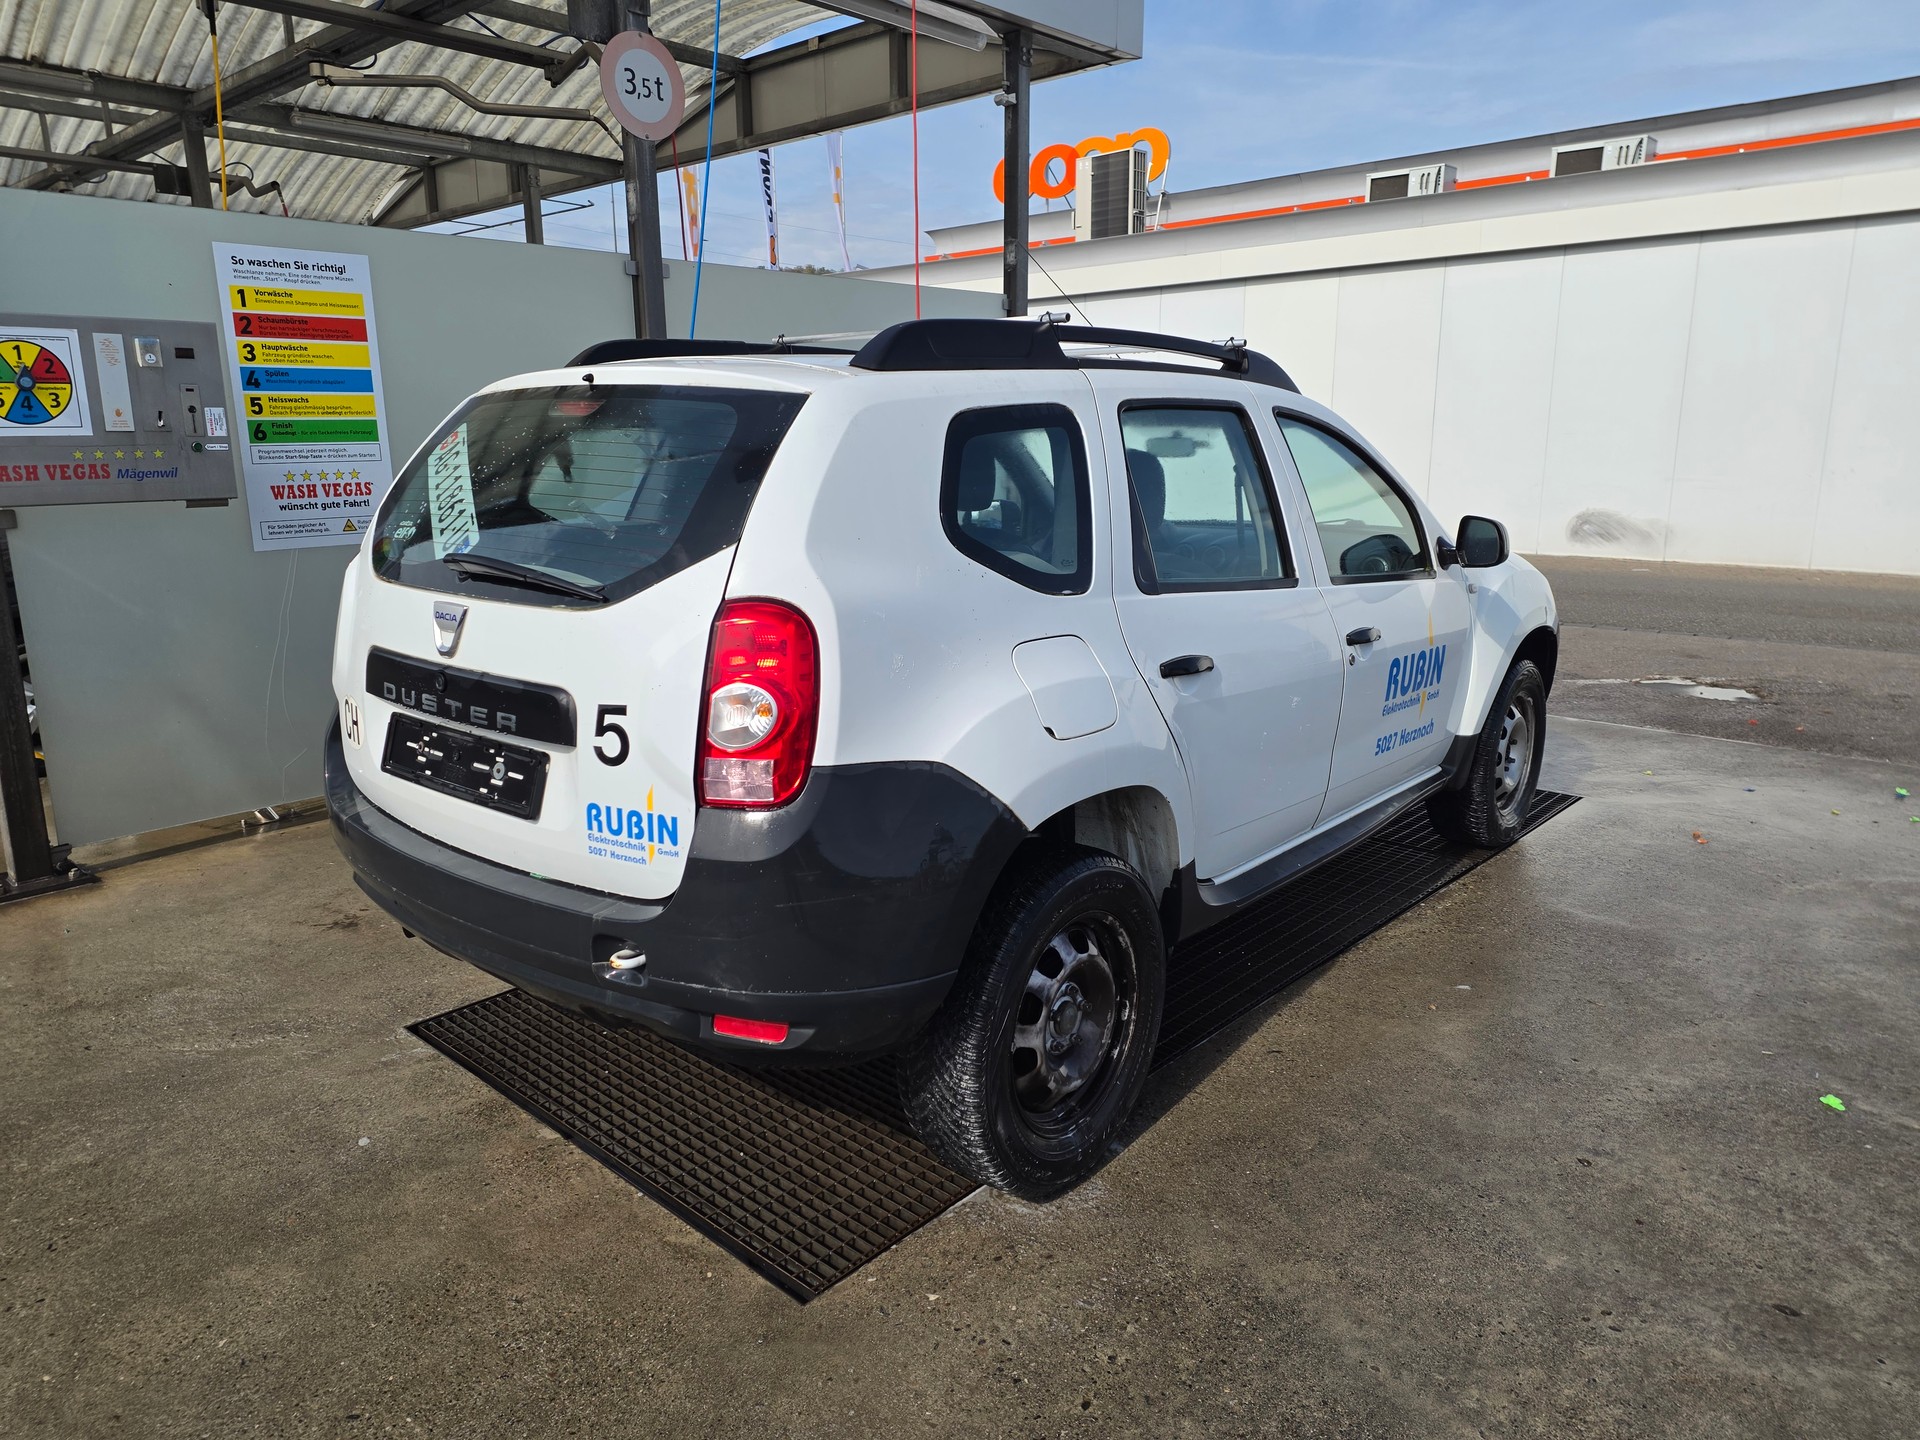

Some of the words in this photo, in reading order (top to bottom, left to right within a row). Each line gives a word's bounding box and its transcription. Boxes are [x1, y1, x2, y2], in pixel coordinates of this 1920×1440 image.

[231, 255, 244, 266] So
[247, 258, 291, 270] waschen
[294, 260, 309, 271] Sie
[312, 262, 347, 276] richtig!
[237, 288, 247, 308] 1
[254, 289, 293, 298] Vorwäsche
[240, 316, 253, 335] 2
[258, 316, 309, 325] Schaumbürste
[12, 344, 22, 361] 1
[242, 343, 256, 362] 3
[261, 343, 309, 352] Hauptwäsche
[43, 357, 57, 374] 2
[265, 370, 289, 378] Spülen
[246, 370, 261, 389] 4
[21, 395, 34, 412] 4
[48, 392, 61, 409] 3
[249, 396, 263, 415] 5
[268, 396, 309, 404] Heisswachs
[294, 404, 325, 412] gleichmässig
[253, 422, 267, 442] 6
[272, 422, 293, 430] Finish
[0, 464, 40, 482] ASH
[44, 463, 111, 481] VEGAS
[117, 467, 178, 482] Mägenwil
[270, 483, 318, 500] WASH
[321, 481, 373, 498] VEGAS
[279, 501, 318, 511] wünscht
[321, 501, 341, 511] gute
[343, 499, 370, 508] Fahrt!
[435, 610, 458, 623] DACIA
[1384, 644, 1447, 702] RUBIN
[384, 681, 517, 732] DUSTER
[1382, 694, 1421, 717] Elektrotechnik
[1426, 688, 1440, 701] GmbH
[344, 697, 361, 747] CH
[593, 703, 630, 767] 5
[1375, 730, 1399, 757] 5027
[1399, 717, 1435, 747] Herznach
[587, 802, 679, 847] RUBIN
[587, 832, 646, 853] Elektrotechnik
[657, 847, 680, 859] GmbH
[588, 846, 608, 858] 5027
[609, 848, 647, 866] Herznach
